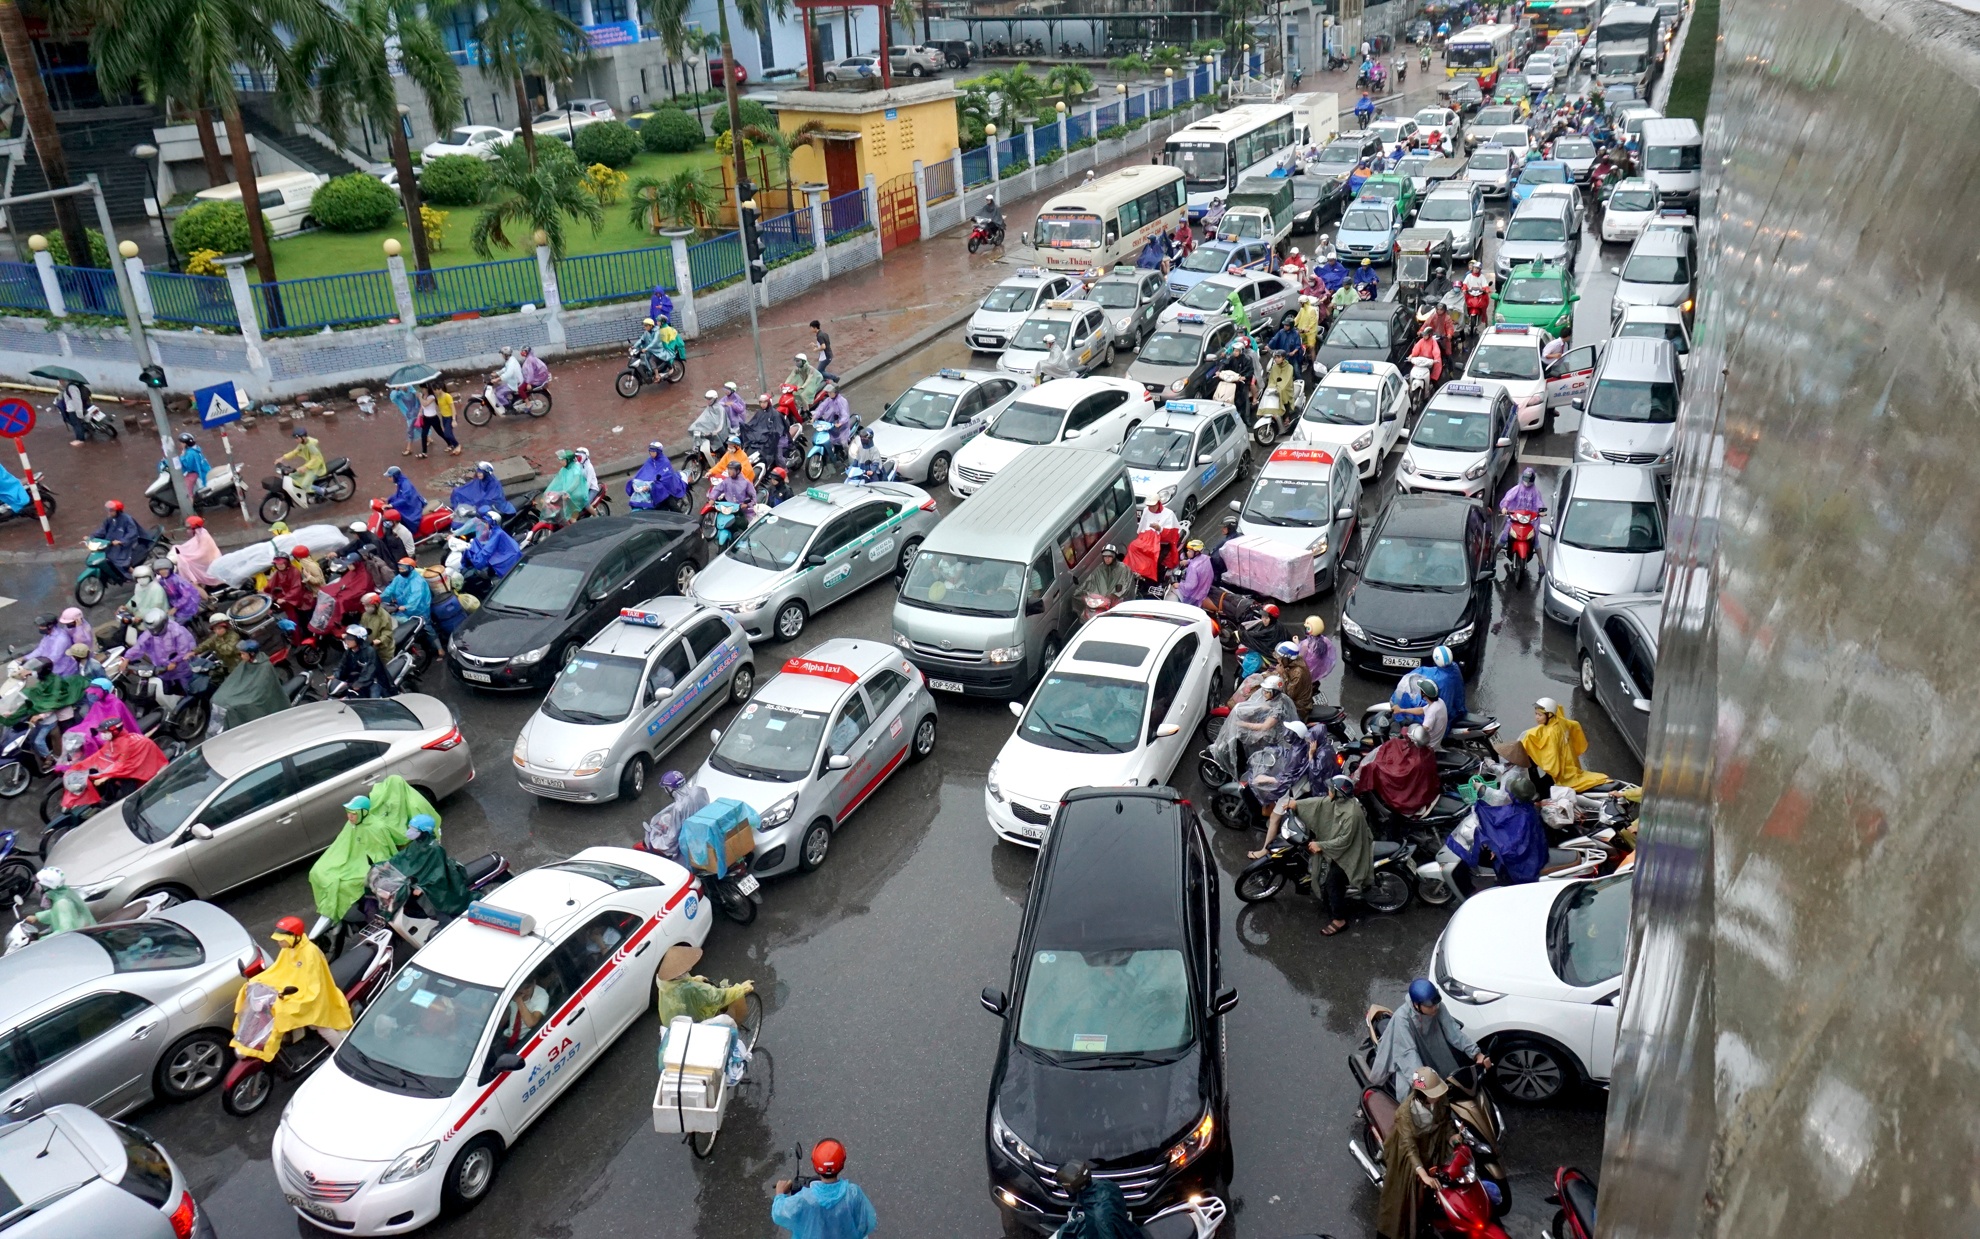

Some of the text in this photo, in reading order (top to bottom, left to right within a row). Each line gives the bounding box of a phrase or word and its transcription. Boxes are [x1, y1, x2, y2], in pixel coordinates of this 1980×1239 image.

[1290, 450, 1309, 459] Alpha
[800, 662, 824, 673] Alpha
[474, 912, 520, 931] TAXIGROUP
[547, 1036, 574, 1063] 3A
[521, 1042, 582, 1104] 38.57.57.57
